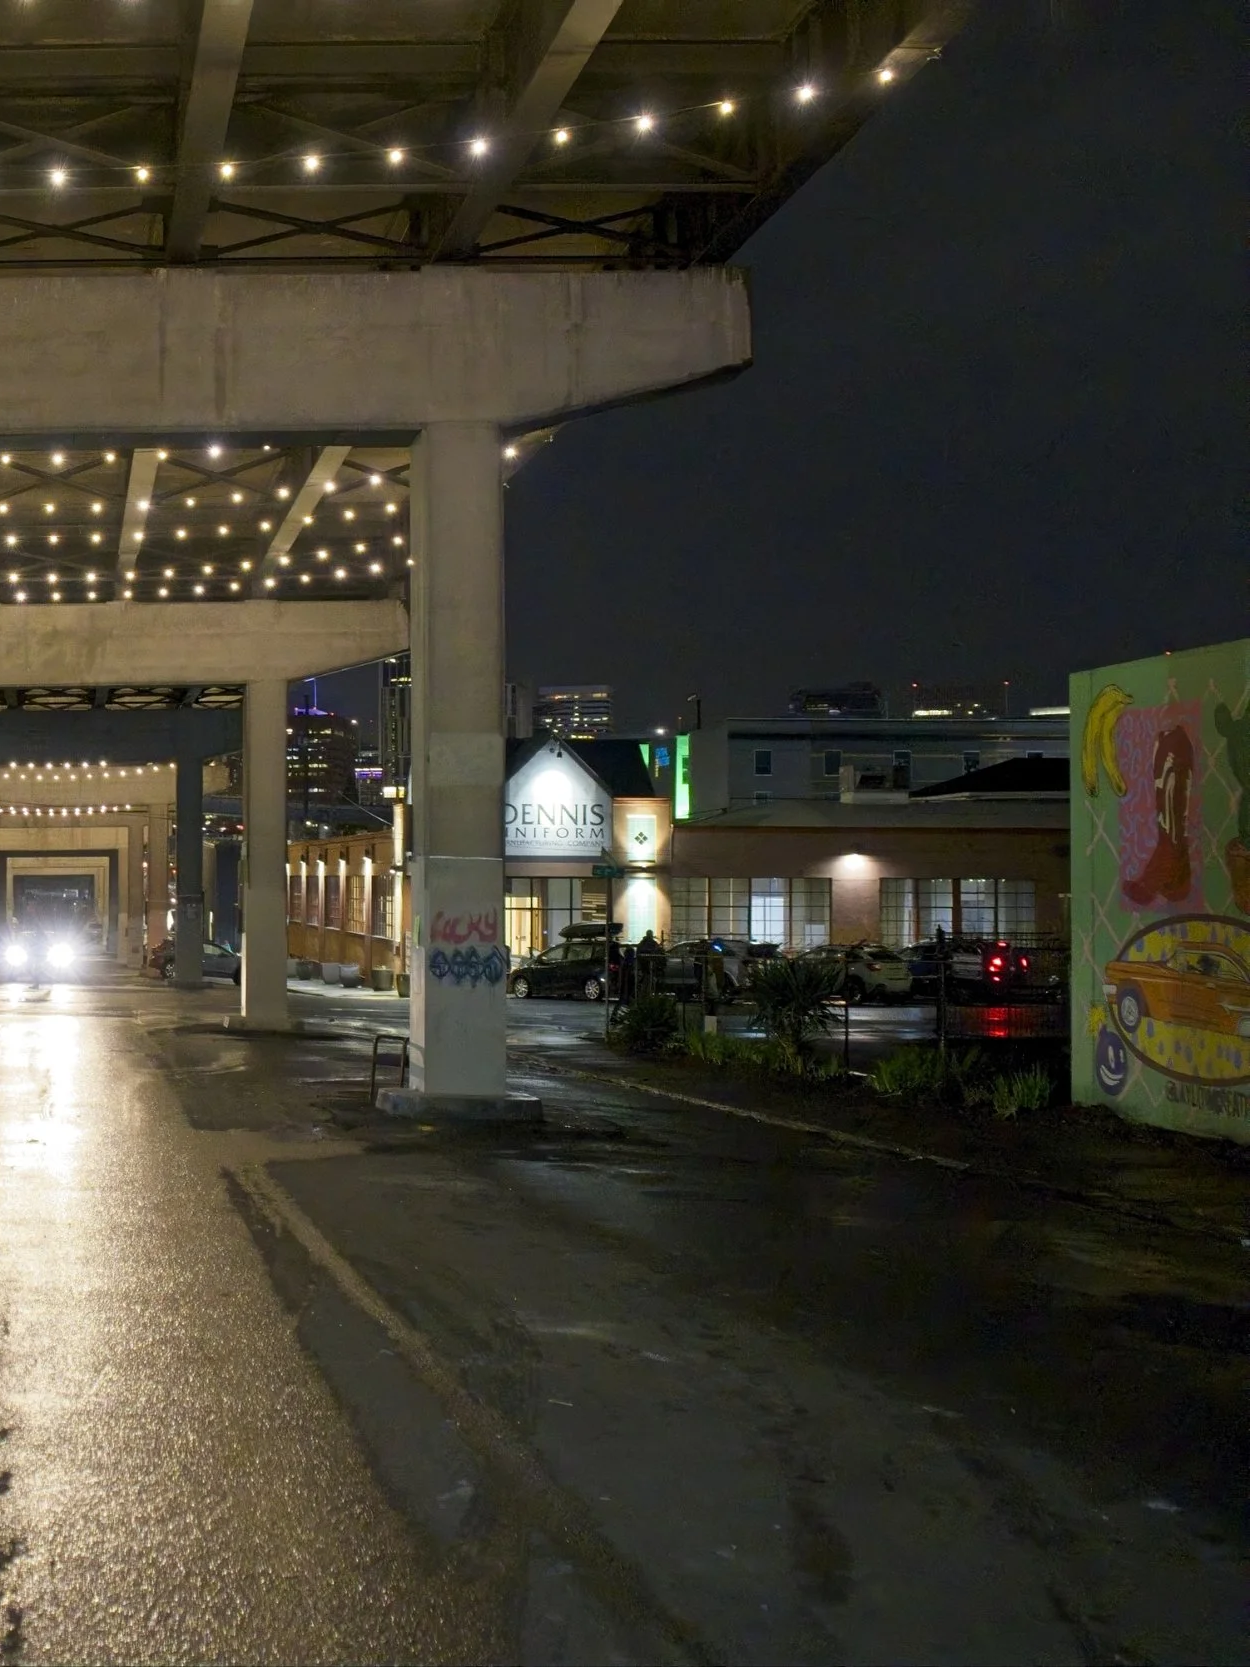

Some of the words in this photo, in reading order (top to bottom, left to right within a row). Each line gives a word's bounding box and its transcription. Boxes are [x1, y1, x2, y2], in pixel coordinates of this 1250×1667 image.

[505, 803, 605, 826] DENNIS
[505, 827, 605, 839] NIFORM
[568, 839, 604, 848] COMPANY
